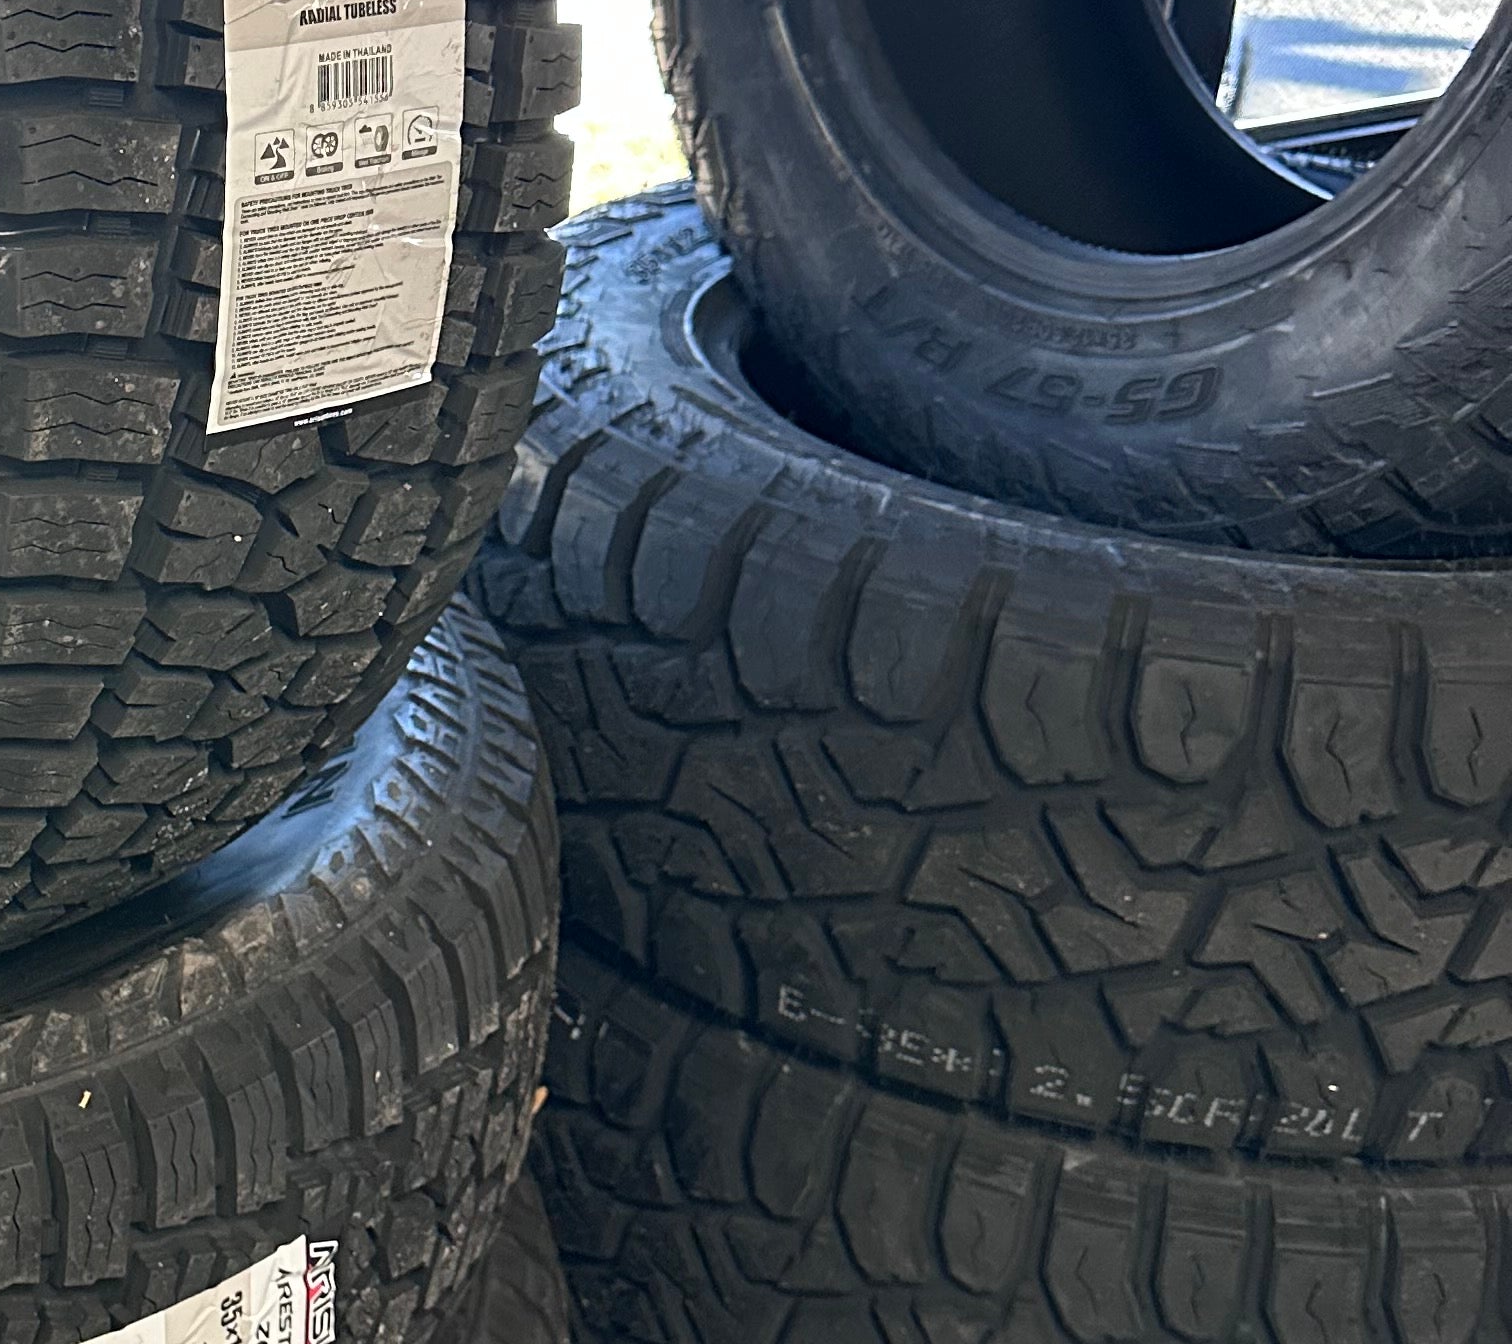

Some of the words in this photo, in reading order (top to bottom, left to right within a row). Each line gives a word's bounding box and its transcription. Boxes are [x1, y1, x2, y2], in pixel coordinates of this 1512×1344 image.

[300, 5, 341, 26] RADIAL
[319, 51, 341, 62] MADE
[343, 50, 351, 59] IN
[353, 44, 392, 56] THAILAND
